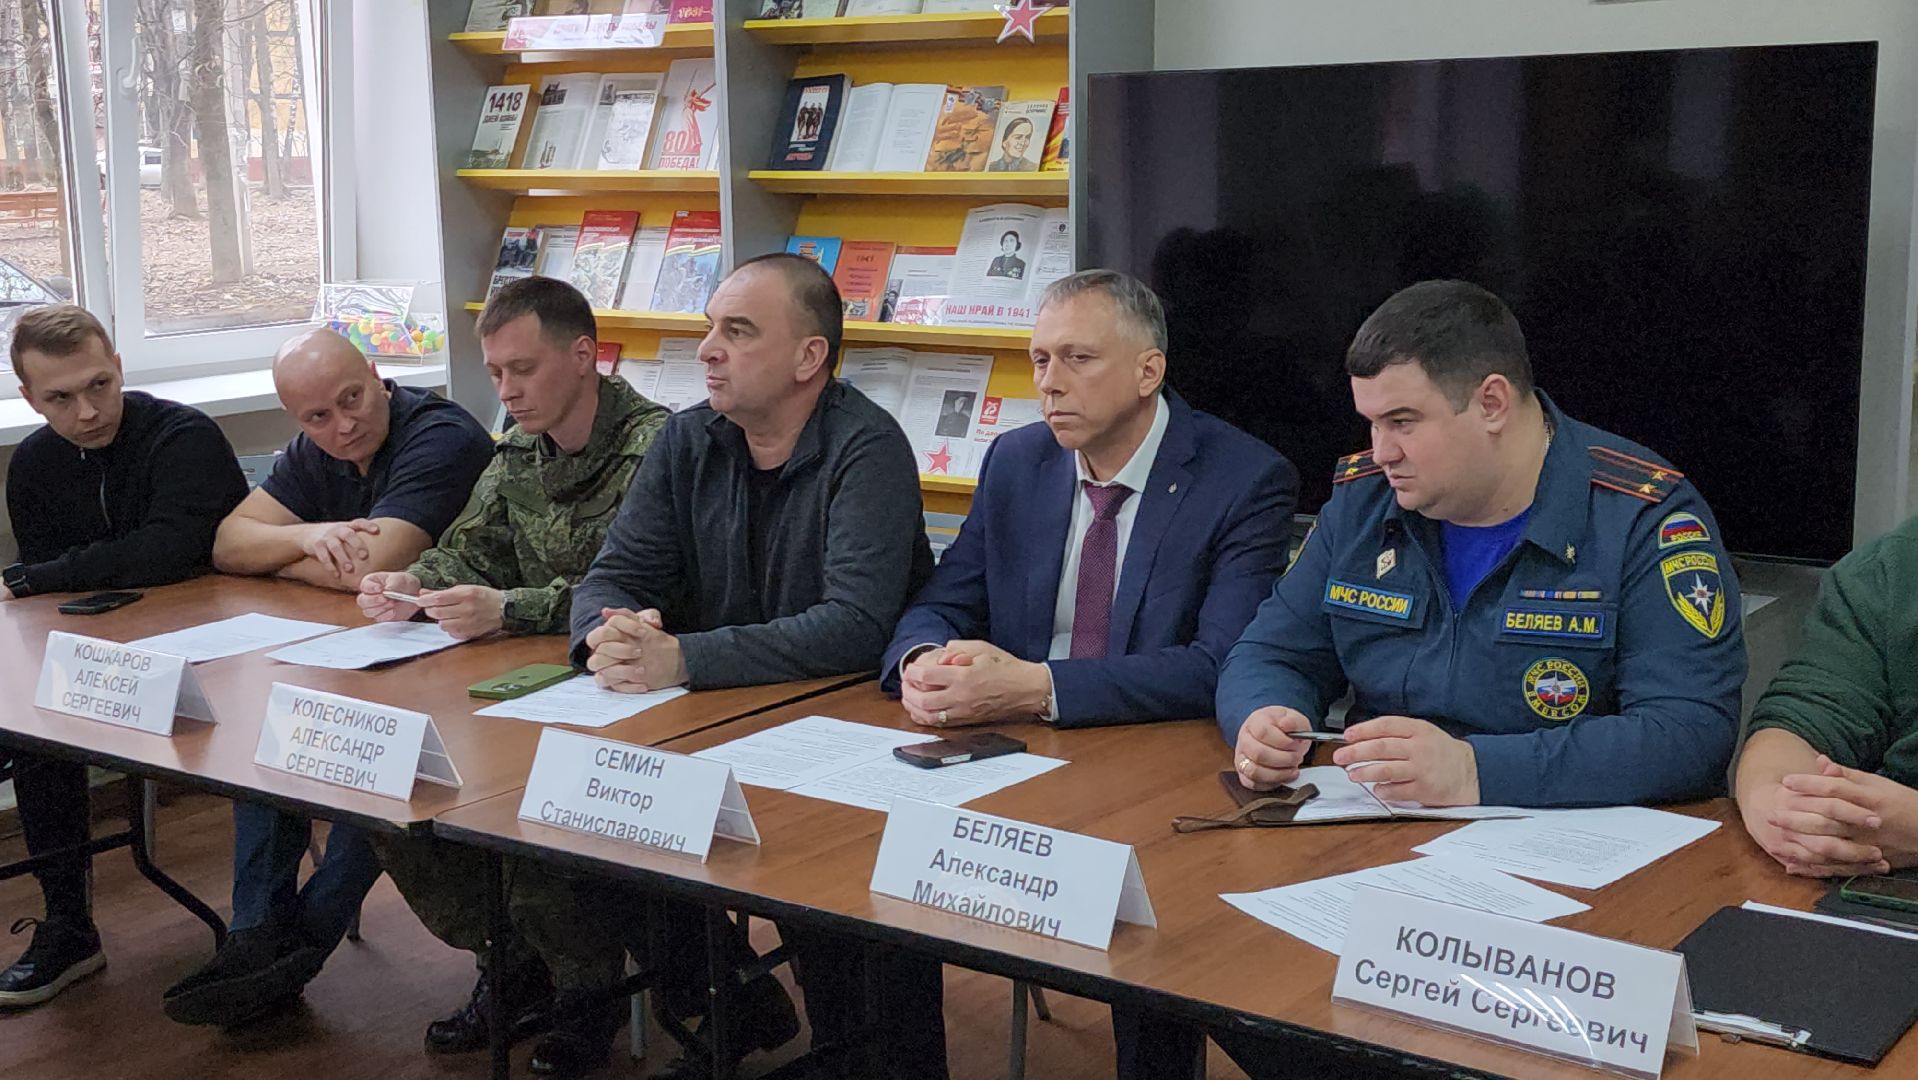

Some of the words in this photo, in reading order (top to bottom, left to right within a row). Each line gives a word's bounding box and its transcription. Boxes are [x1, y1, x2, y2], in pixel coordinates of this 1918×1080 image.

[488, 91, 523, 113] 1418
[662, 130, 688, 153] 80
[657, 156, 700, 172] ПОБЕДА!
[945, 304, 967, 315] НАШ
[1007, 306, 1031, 318] 1941
[1664, 556, 1686, 574] МЧС
[1329, 584, 1357, 604] МЧС
[1358, 590, 1409, 614] РОССИИ
[1505, 612, 1563, 631] БЕЛЯЕВ
[73, 642, 151, 672] КОШКАРОВ
[1527, 662, 1545, 684] МЧС
[74, 669, 139, 697] АЛЕКСЕЙ
[61, 691, 142, 723] СЕРГЕЕВИЧ
[291, 697, 397, 737] КОЛЕСНИКОВ
[1526, 690, 1587, 718] EMERCOM
[289, 728, 385, 762] АЛЕКСАНДР
[285, 753, 377, 790] СЕРГЕЕВИЧ
[594, 747, 666, 779] СЕМИН
[585, 777, 654, 813] Виктор
[539, 801, 687, 854] Станиславович
[952, 816, 1054, 859] БЕЛЯЕВ
[929, 849, 1059, 901] Александр
[912, 881, 1062, 939] Михайлович
[1395, 925, 1617, 1001] КОЛЫВАНОВ
[1354, 958, 1460, 1008] Сергей
[1471, 986, 1649, 1054] Сергеевич
